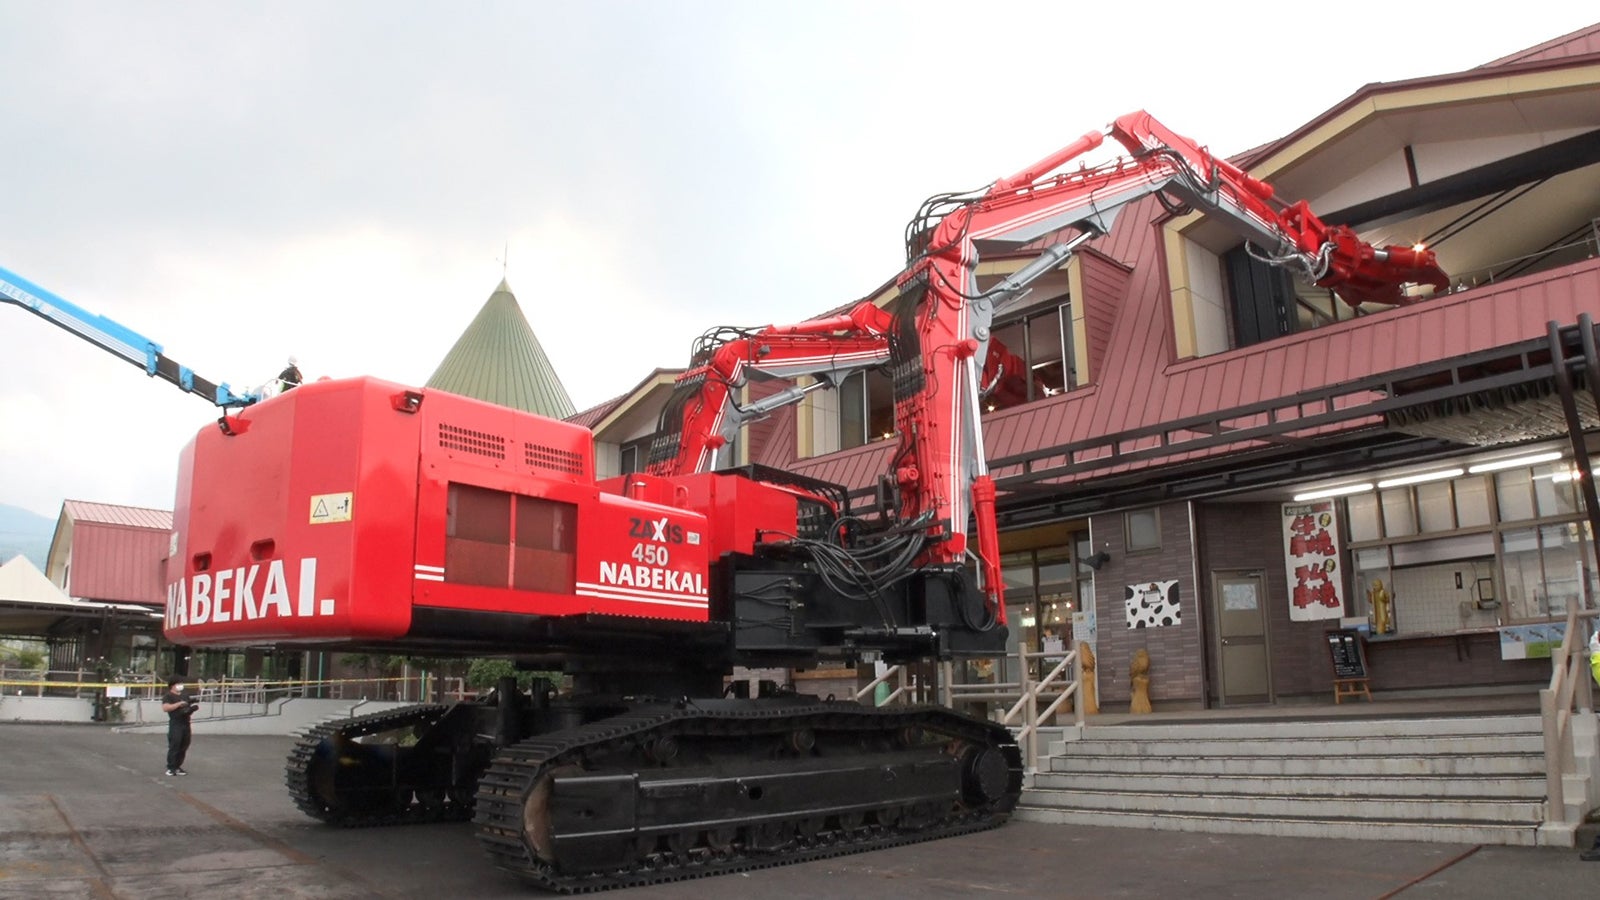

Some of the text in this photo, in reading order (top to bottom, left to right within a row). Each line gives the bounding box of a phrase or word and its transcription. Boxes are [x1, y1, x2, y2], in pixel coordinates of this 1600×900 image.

[628, 517, 684, 545] ZAXIS
[631, 543, 670, 566] 450
[164, 557, 336, 630] NABEKAI.
[599, 561, 708, 595] NABEKAI.
